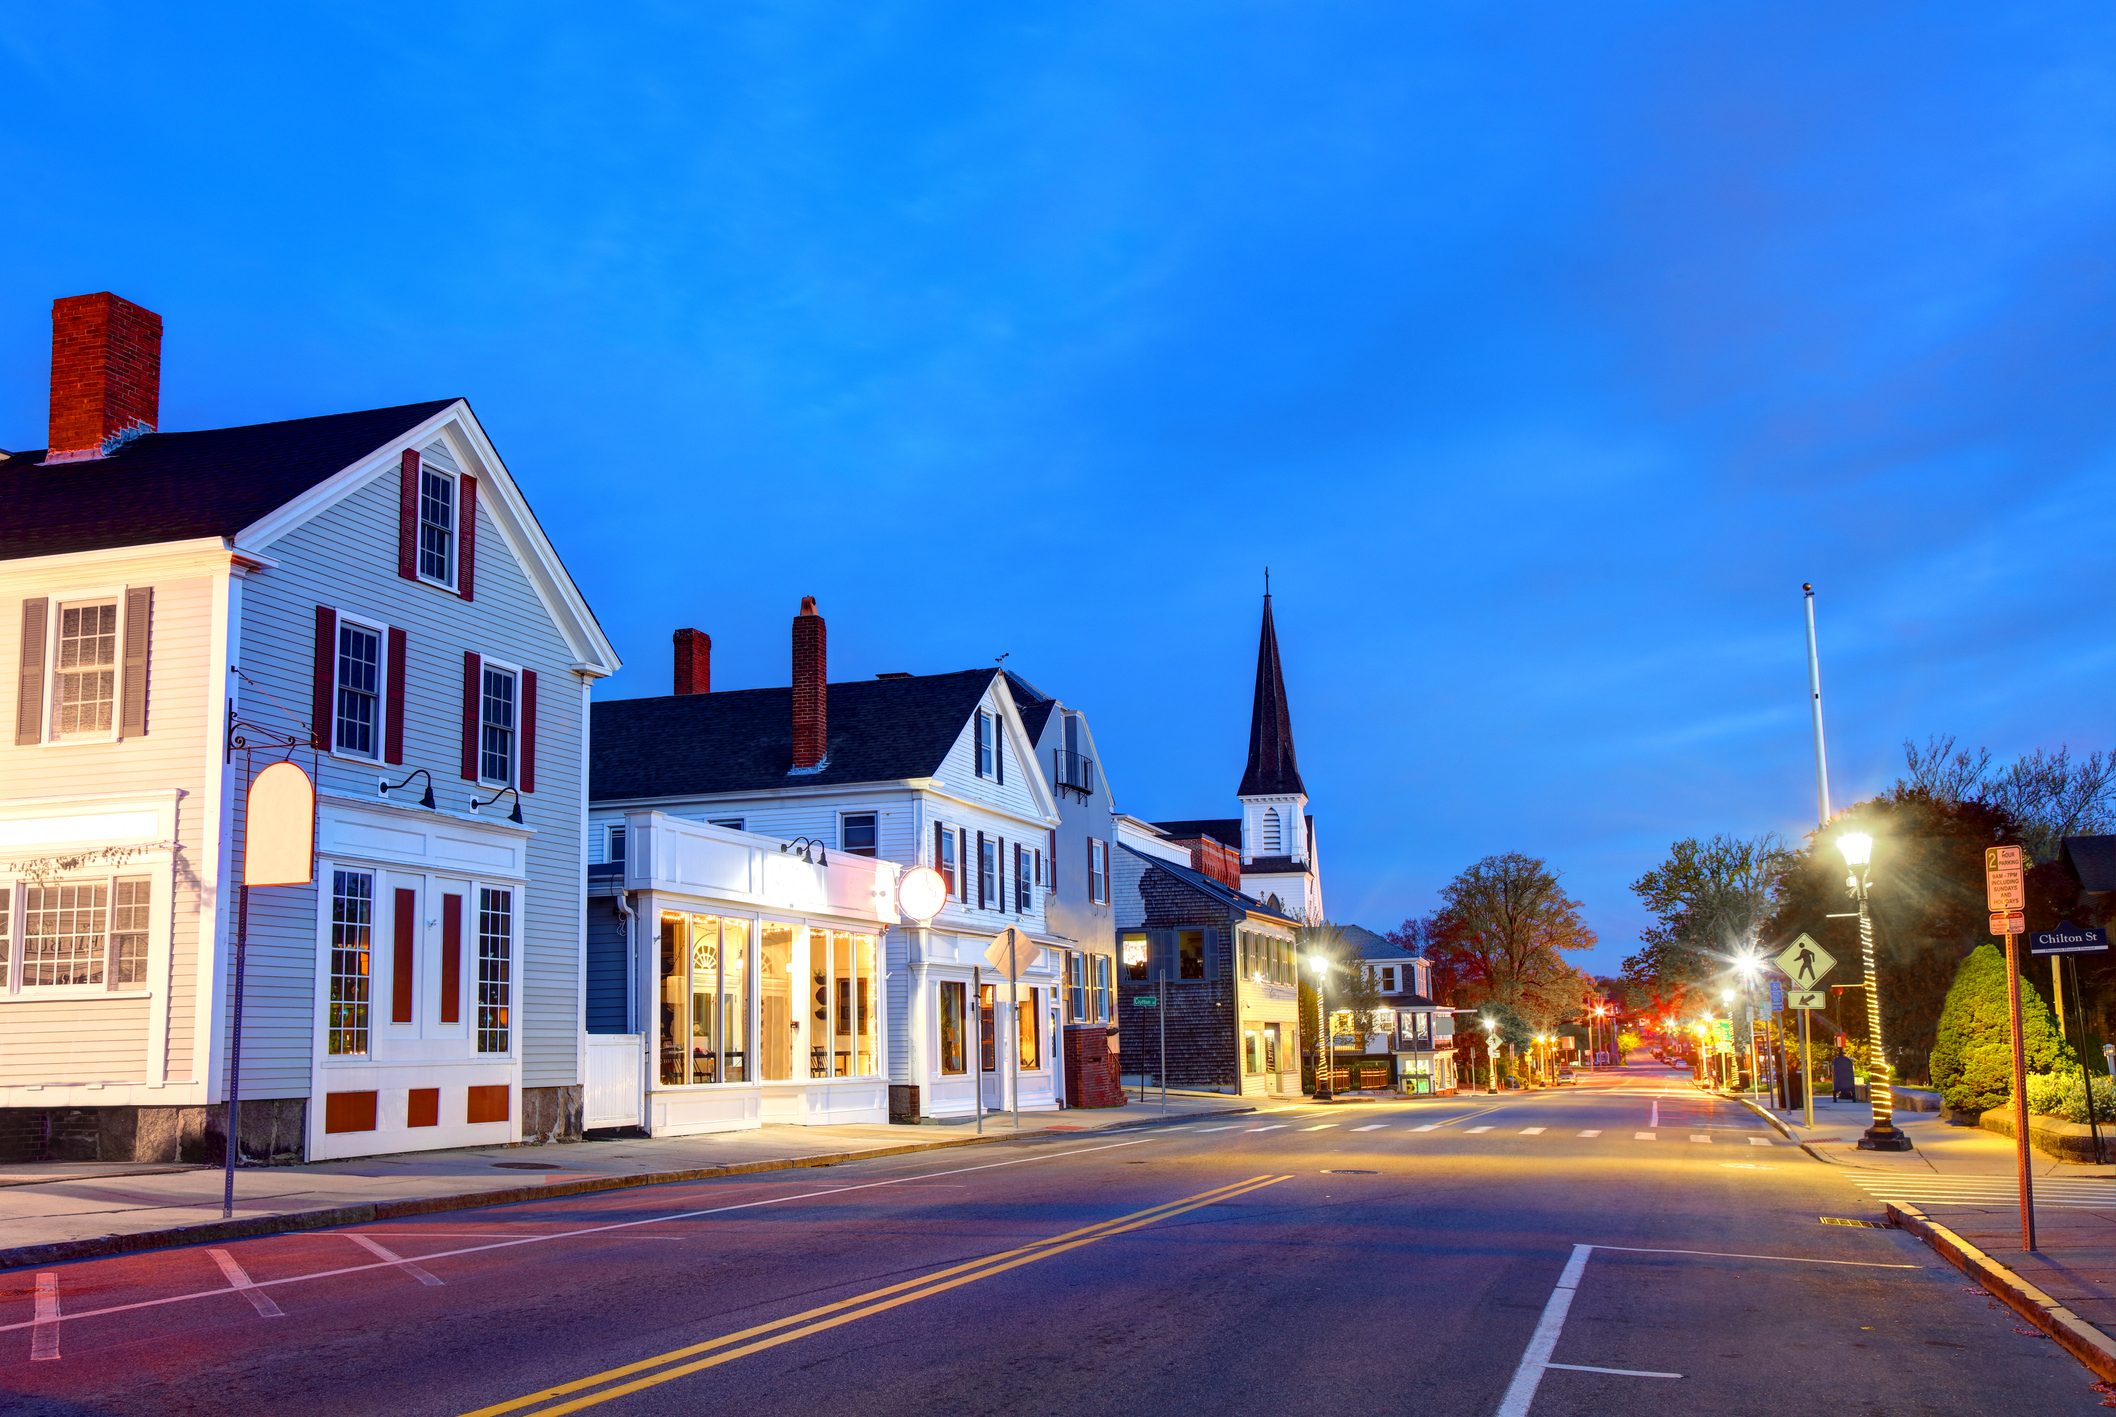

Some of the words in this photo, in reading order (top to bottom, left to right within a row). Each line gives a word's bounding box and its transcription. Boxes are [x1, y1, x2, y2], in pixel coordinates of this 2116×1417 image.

[1988, 852, 1996, 868] 2
[2039, 934, 2082, 944] Chilton
[2086, 932, 2098, 941] St
